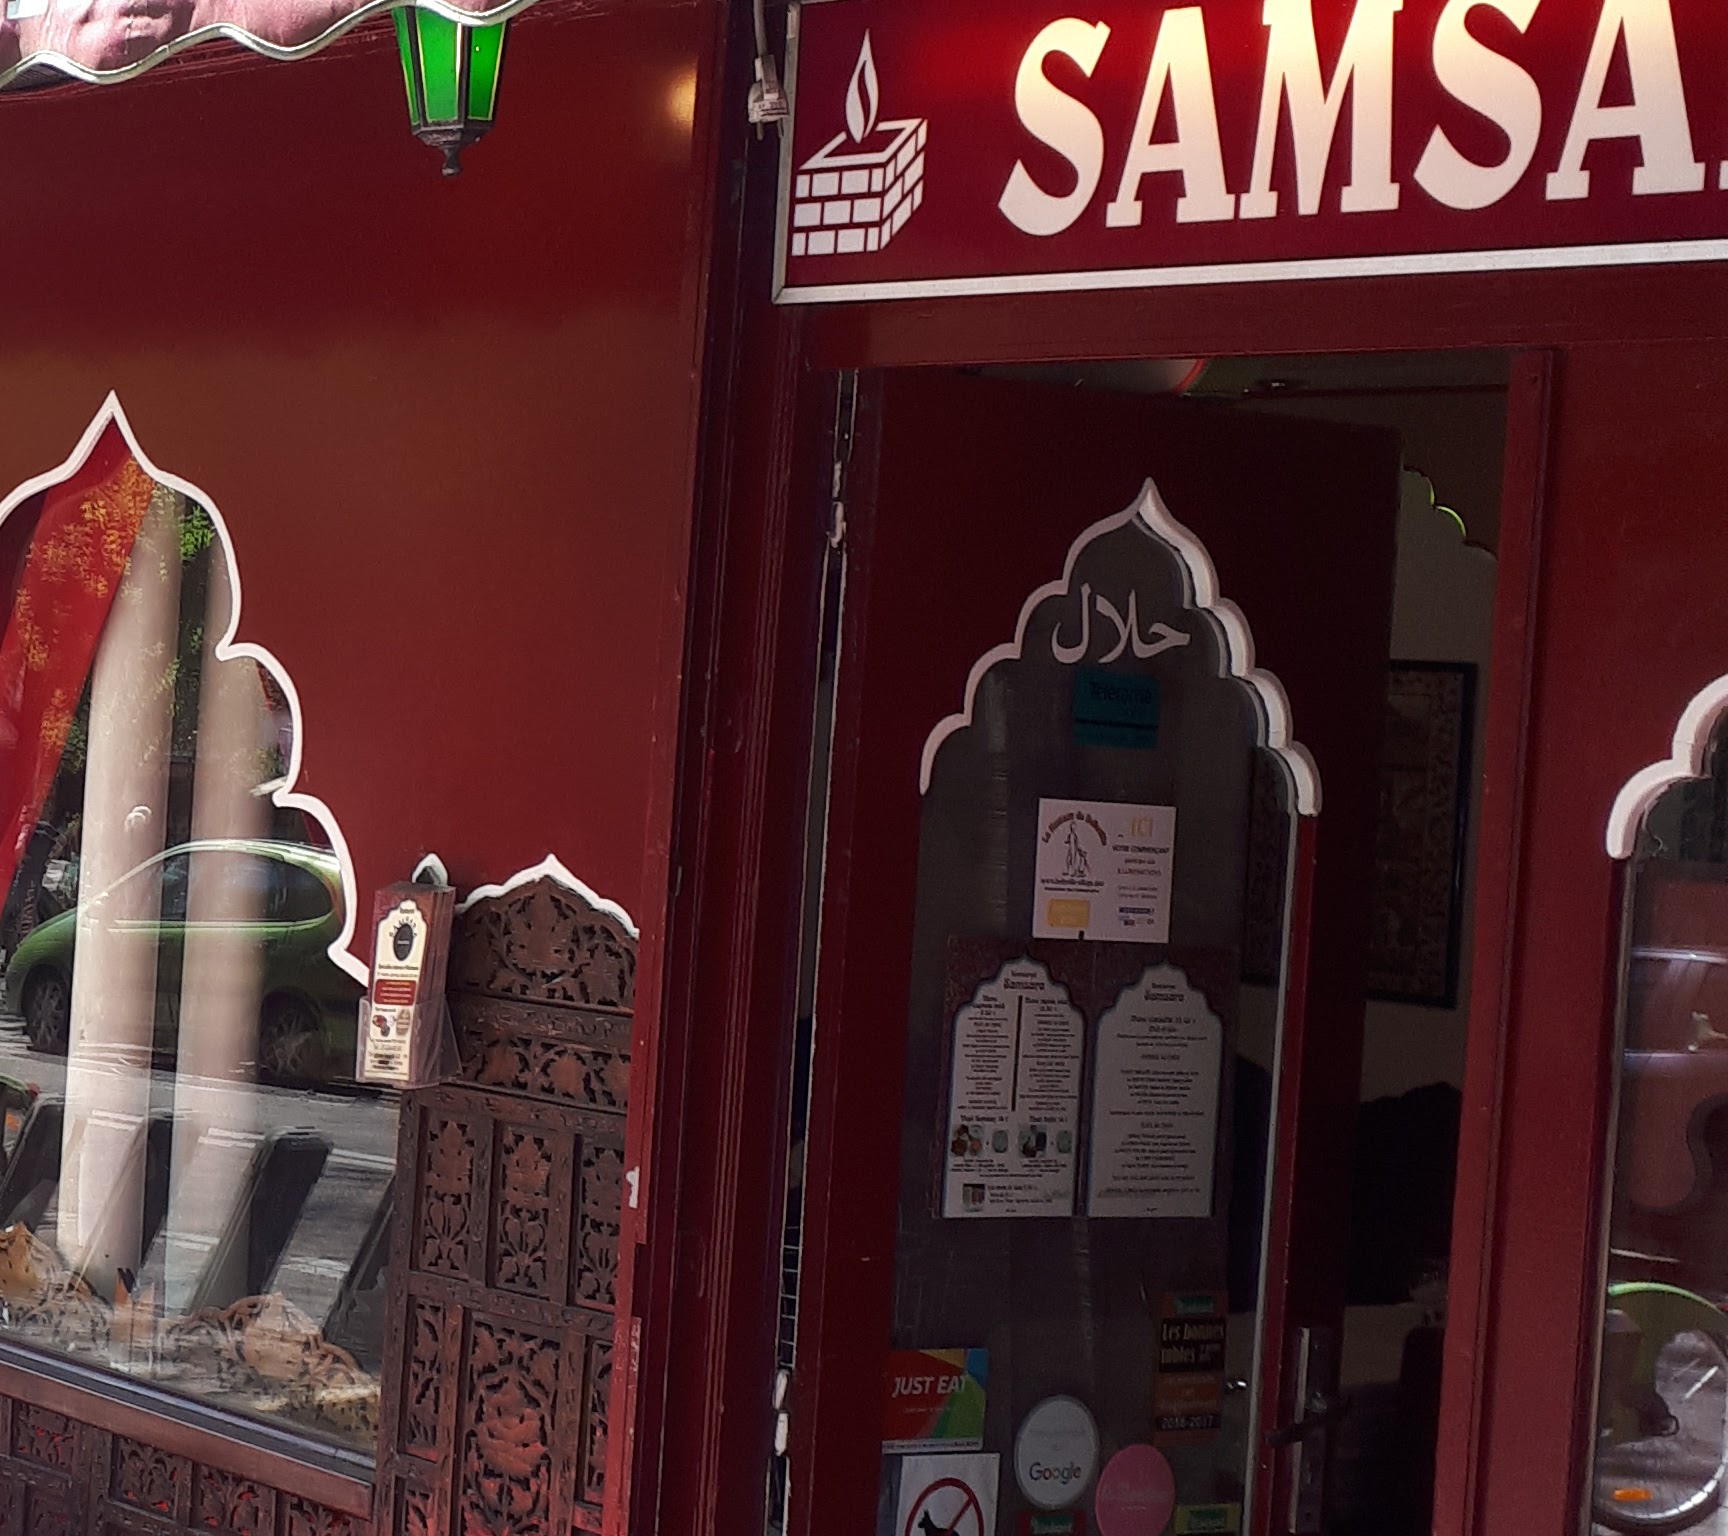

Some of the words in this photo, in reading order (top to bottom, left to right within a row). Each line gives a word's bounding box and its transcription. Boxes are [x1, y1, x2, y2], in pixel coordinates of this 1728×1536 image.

[1052, 581, 1192, 664] حلال
[891, 1375, 935, 1399] JUST
[936, 1374, 967, 1395] EAT
[1028, 1461, 1082, 1485] Google
